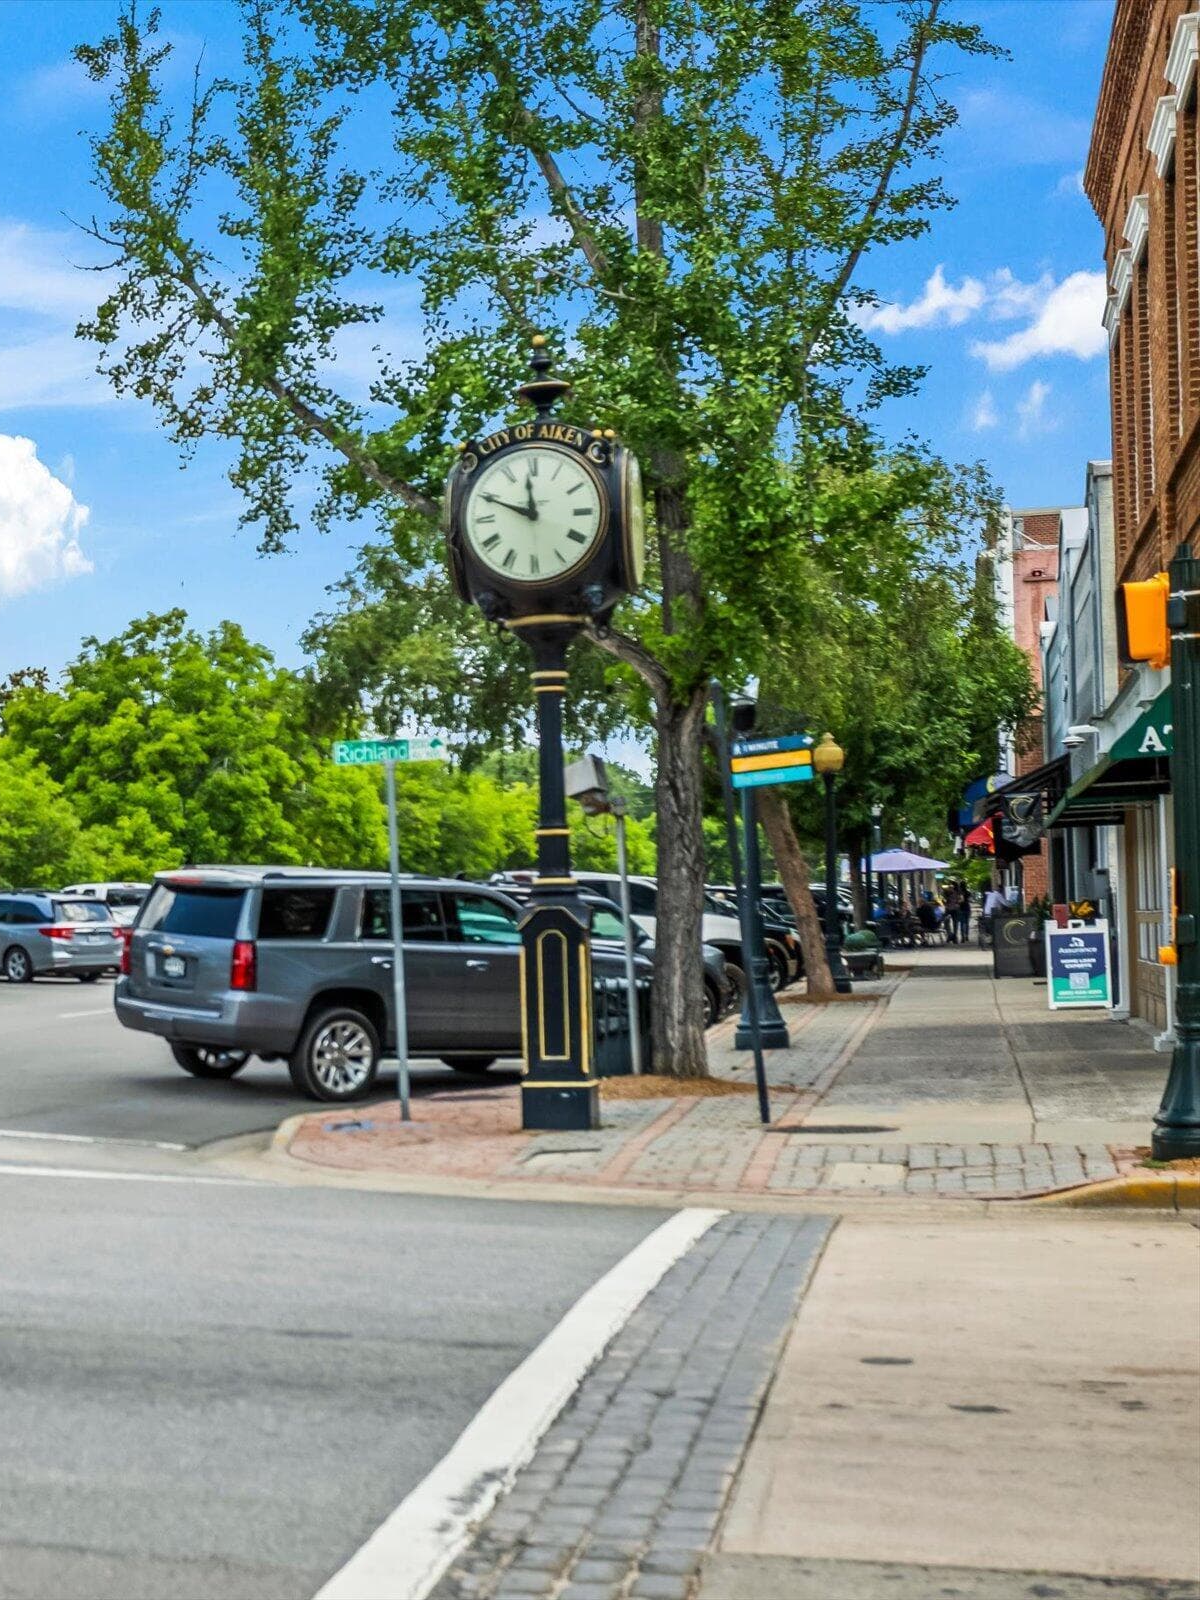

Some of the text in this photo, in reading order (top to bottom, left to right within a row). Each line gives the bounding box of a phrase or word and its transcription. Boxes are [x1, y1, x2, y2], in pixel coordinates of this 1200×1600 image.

[479, 424, 582, 454] CITY OF AIKEN
[337, 742, 408, 764] Richland
